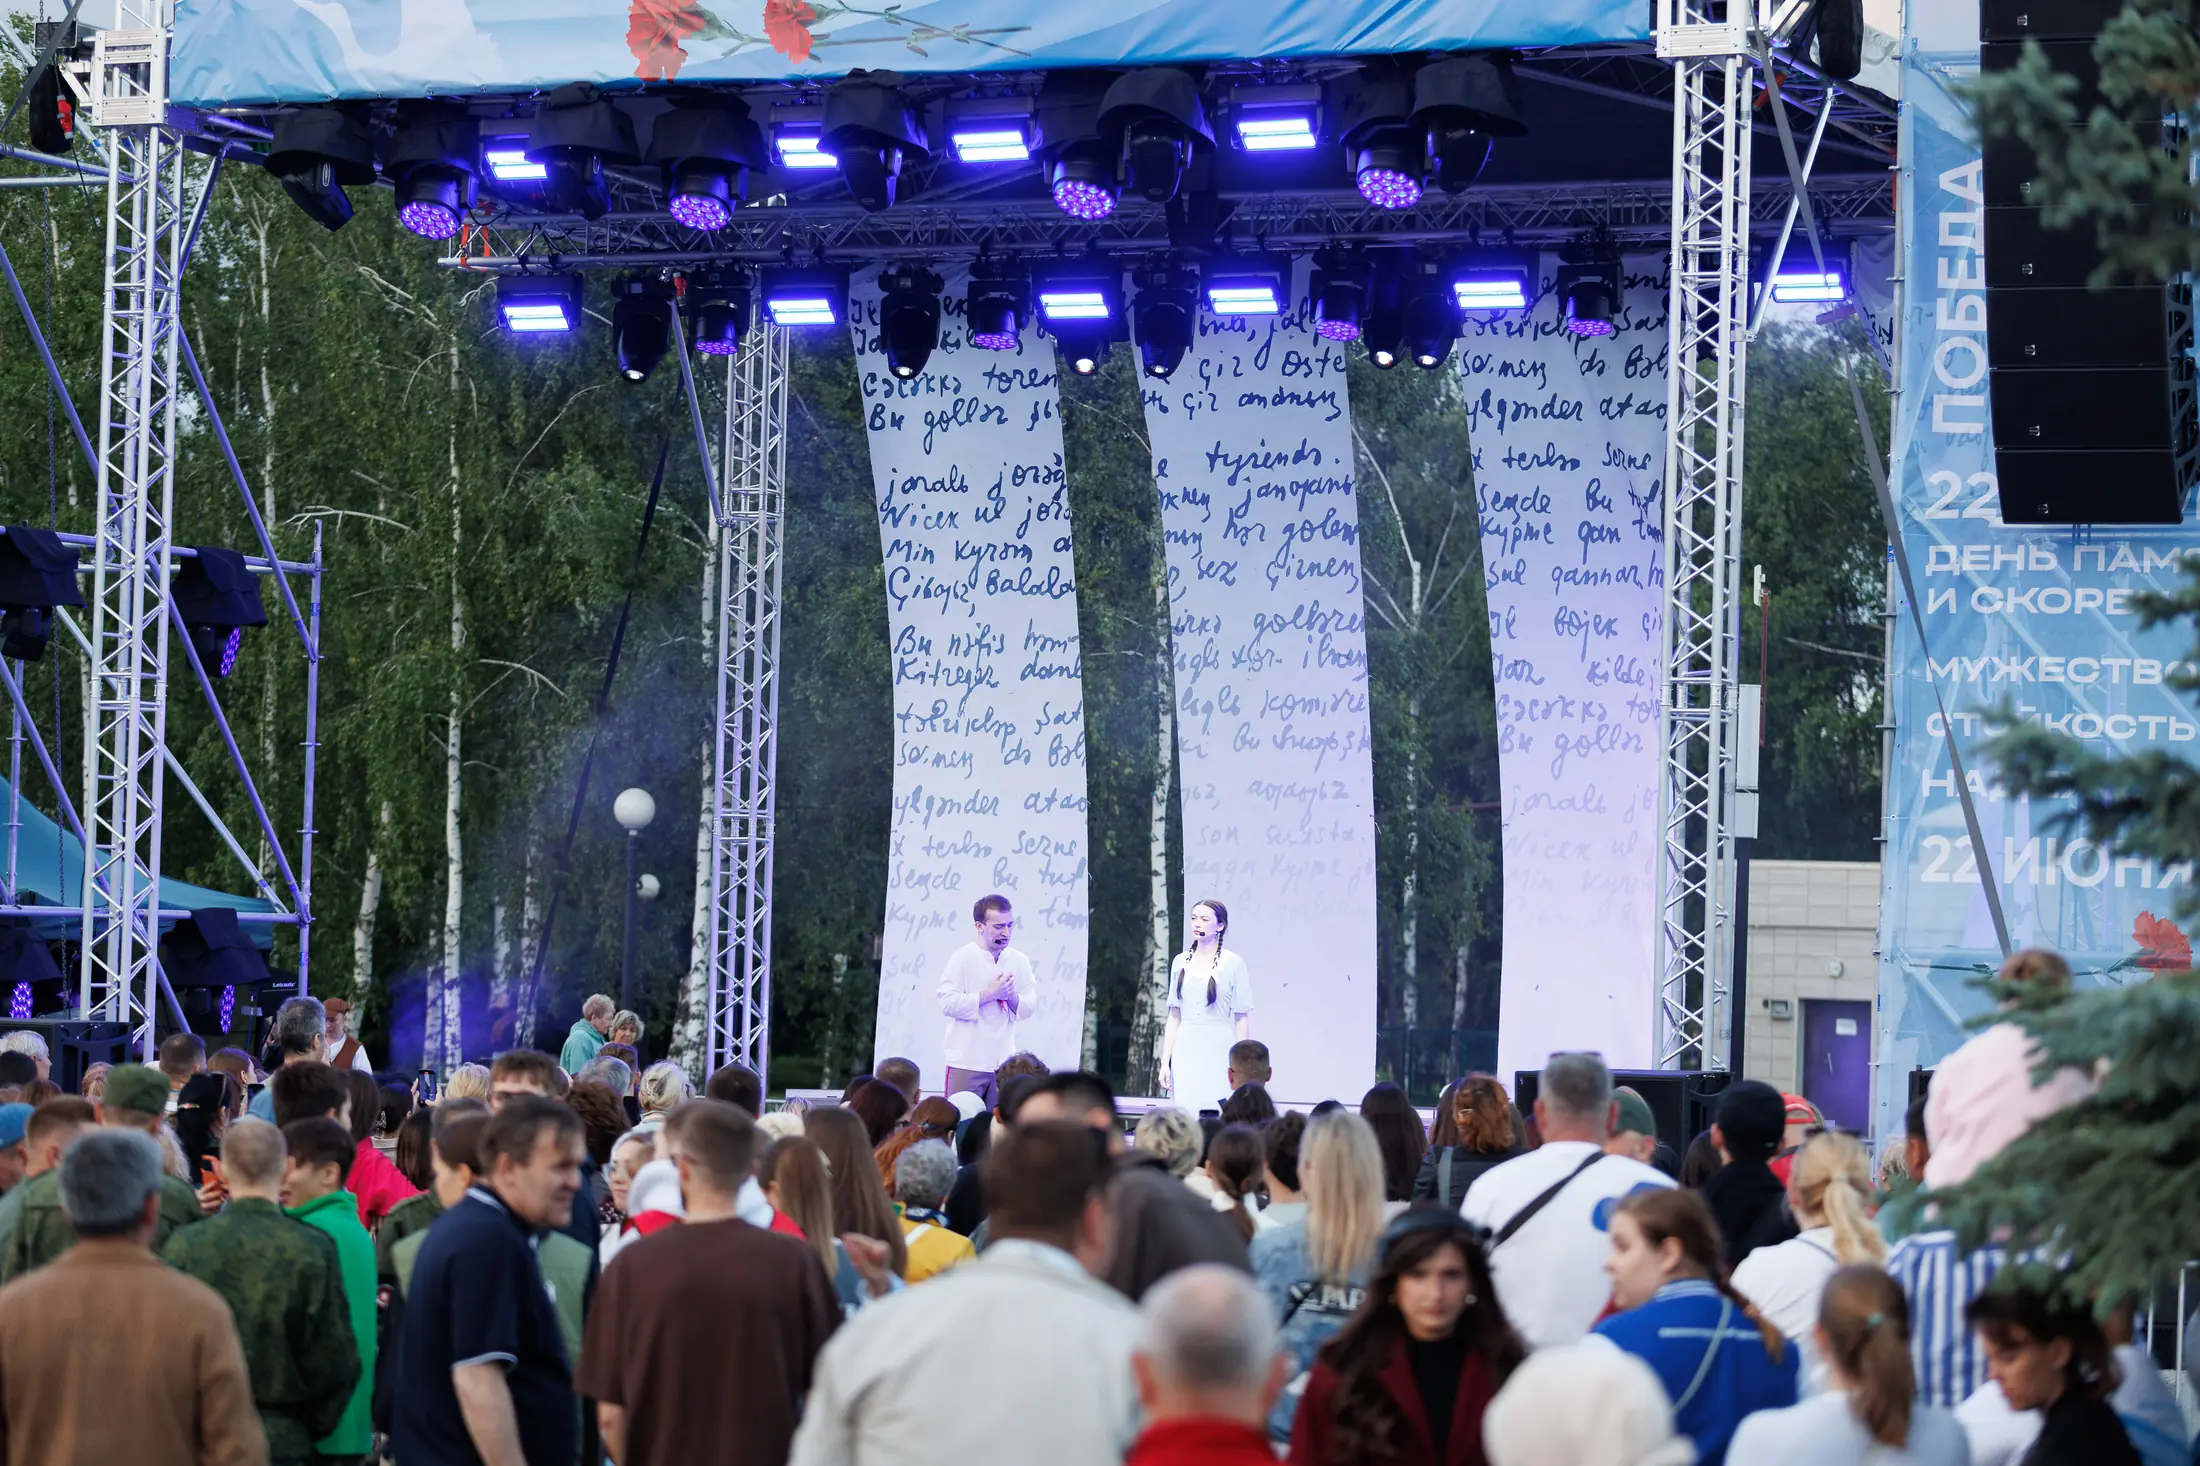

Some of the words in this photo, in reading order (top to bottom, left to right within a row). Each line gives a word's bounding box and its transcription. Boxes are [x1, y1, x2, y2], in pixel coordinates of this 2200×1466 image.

[1931, 157, 1988, 434] ПОБЕДА
[1925, 544, 2058, 577] ДЕНЬ
[1927, 587, 1957, 615] И
